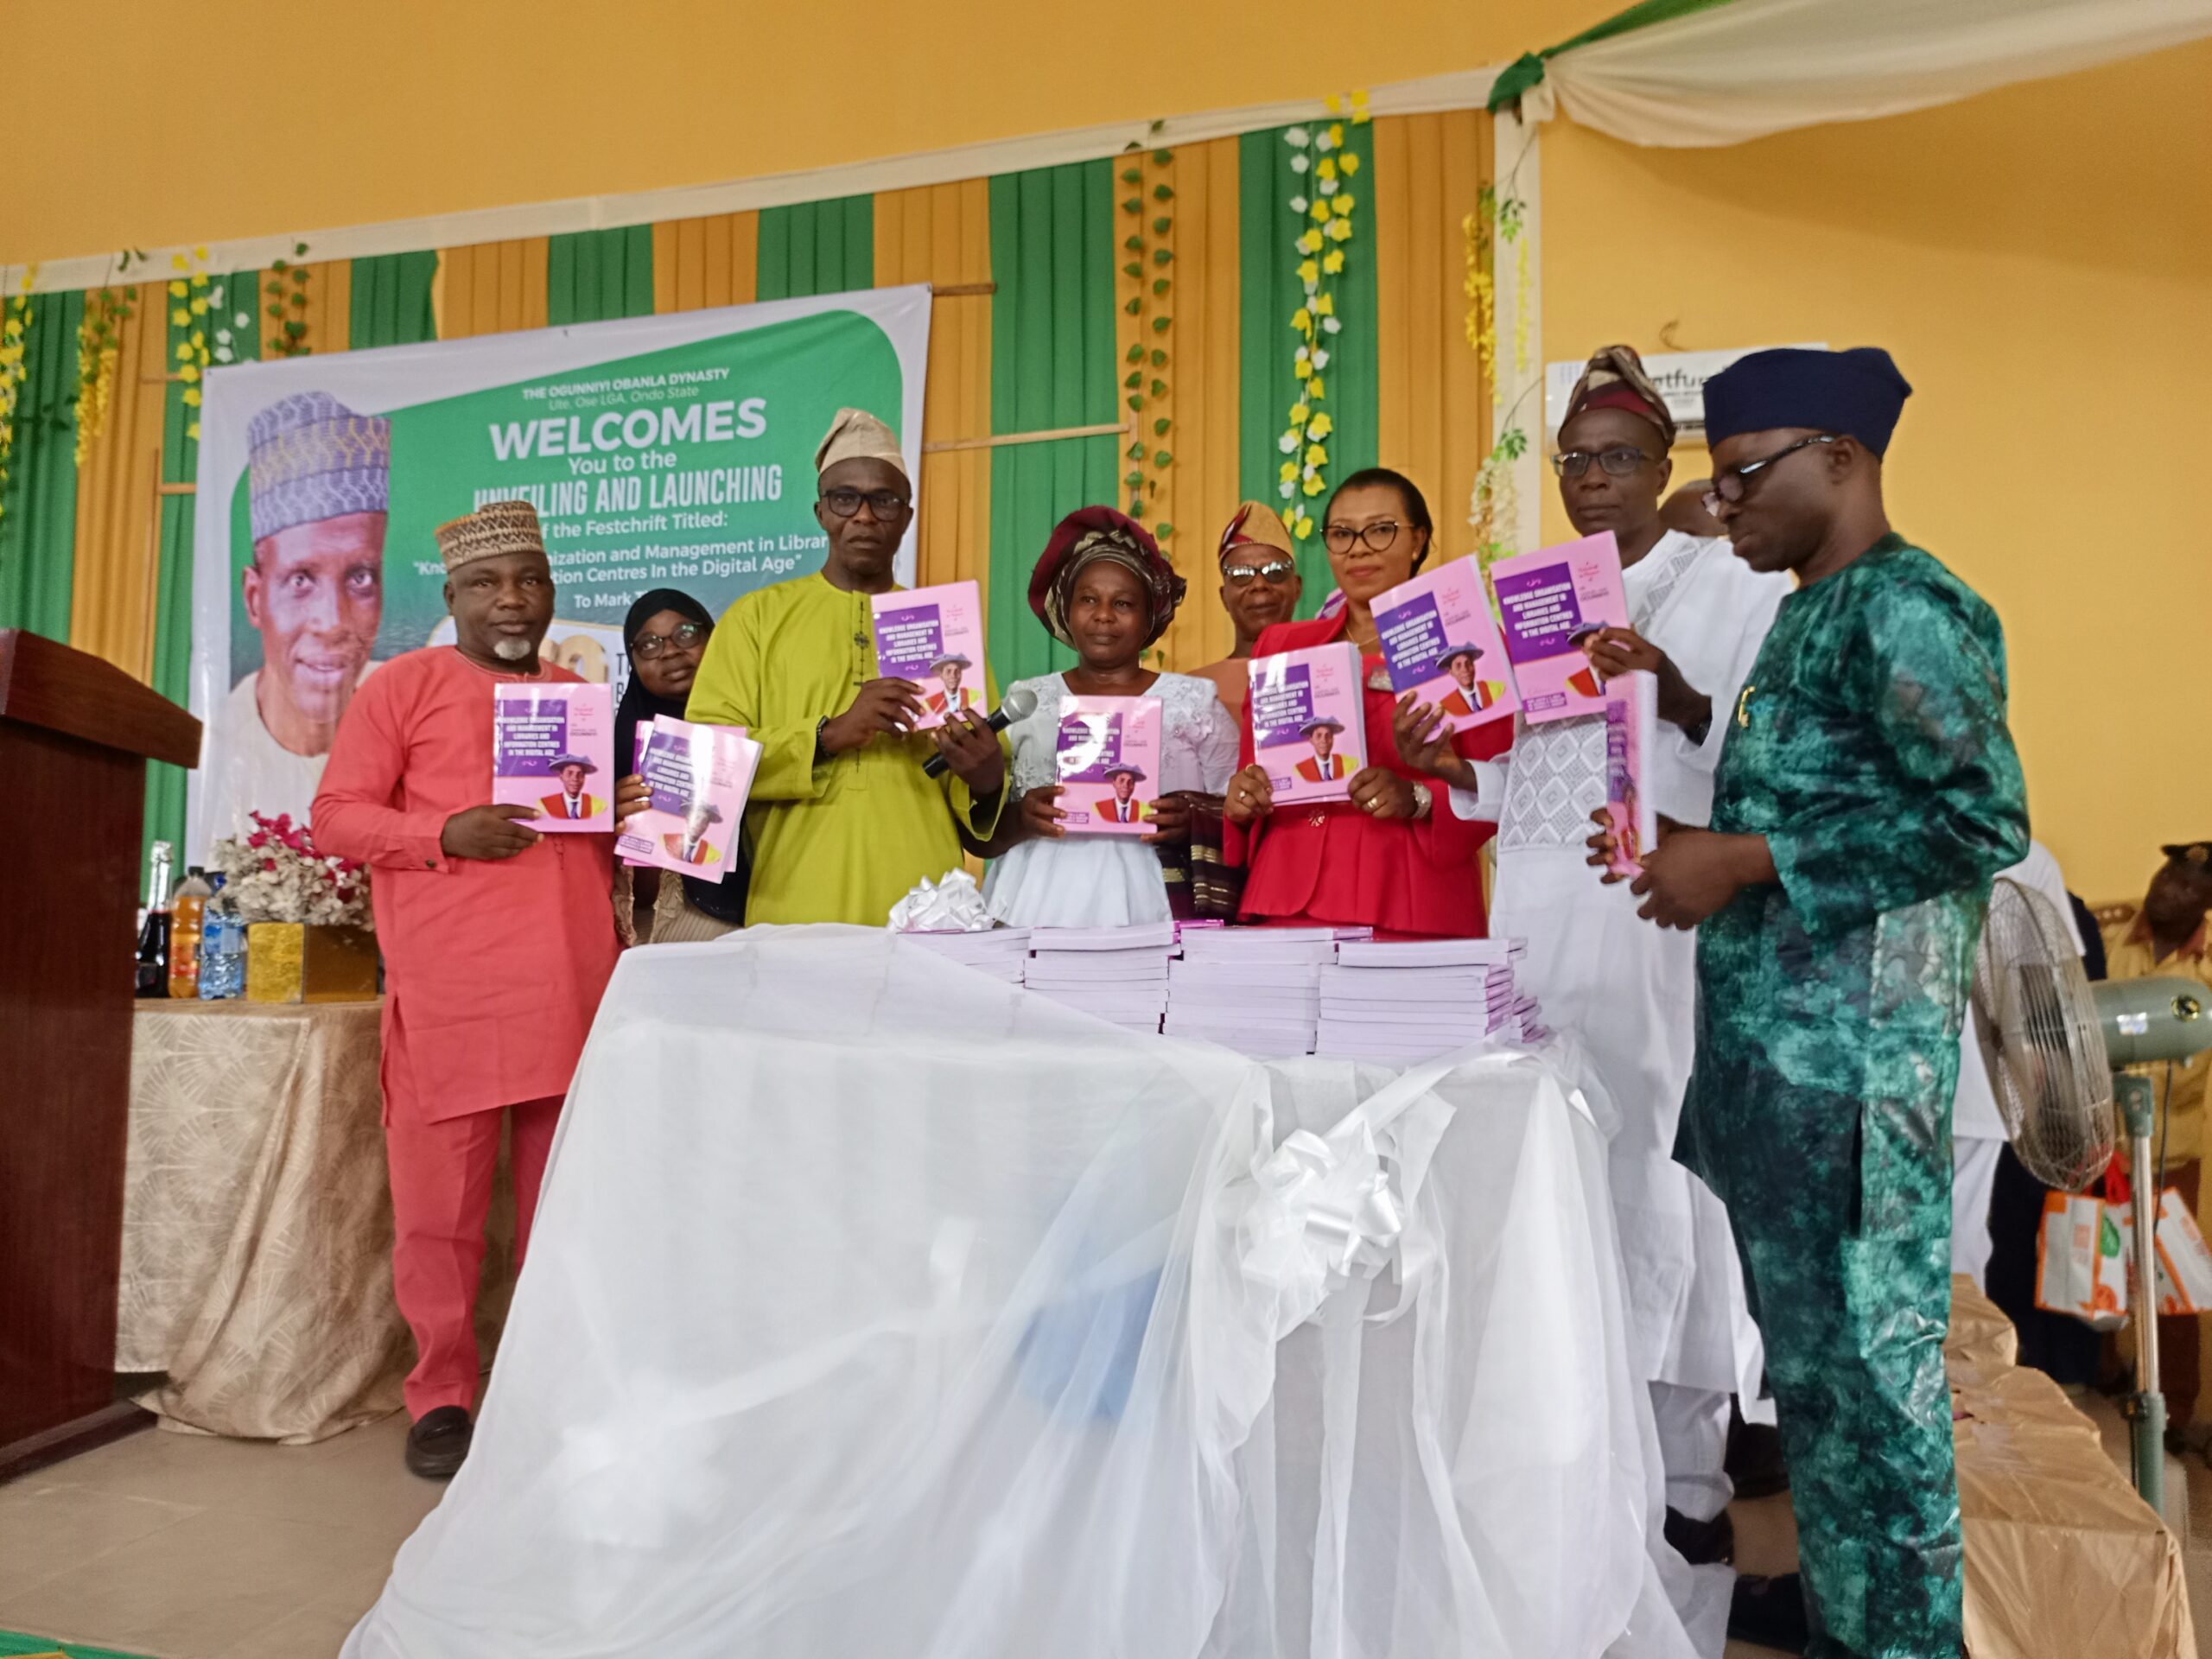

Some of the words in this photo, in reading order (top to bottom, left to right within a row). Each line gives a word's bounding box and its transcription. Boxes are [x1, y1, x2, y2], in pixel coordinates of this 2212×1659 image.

[523, 387, 546, 400] THE
[549, 380, 611, 397] OGUNNIYI
[613, 375, 666, 391] OBANLA
[669, 368, 730, 385] DYNASTY
[575, 396, 598, 409] Ose
[631, 388, 664, 403] Ondo
[667, 385, 699, 398] State
[488, 397, 767, 461] WELCOMES
[568, 456, 607, 475] You
[613, 454, 635, 471] to
[640, 449, 677, 469] the
[594, 476, 641, 514] AND
[650, 464, 783, 510] LAUNCHING
[552, 522, 582, 538] the
[585, 514, 668, 537] Festchrift
[672, 511, 728, 529] Titled:
[546, 550, 607, 567] nization
[609, 547, 641, 564] and
[645, 539, 754, 561] Management
[759, 537, 774, 551] in
[779, 534, 828, 551] Librar
[587, 563, 647, 582] Centres
[651, 561, 667, 578] In
[671, 562, 698, 577] the
[702, 556, 757, 578] Digital
[761, 554, 802, 575] Age"
[574, 594, 591, 608] To
[594, 591, 632, 607] Mark
